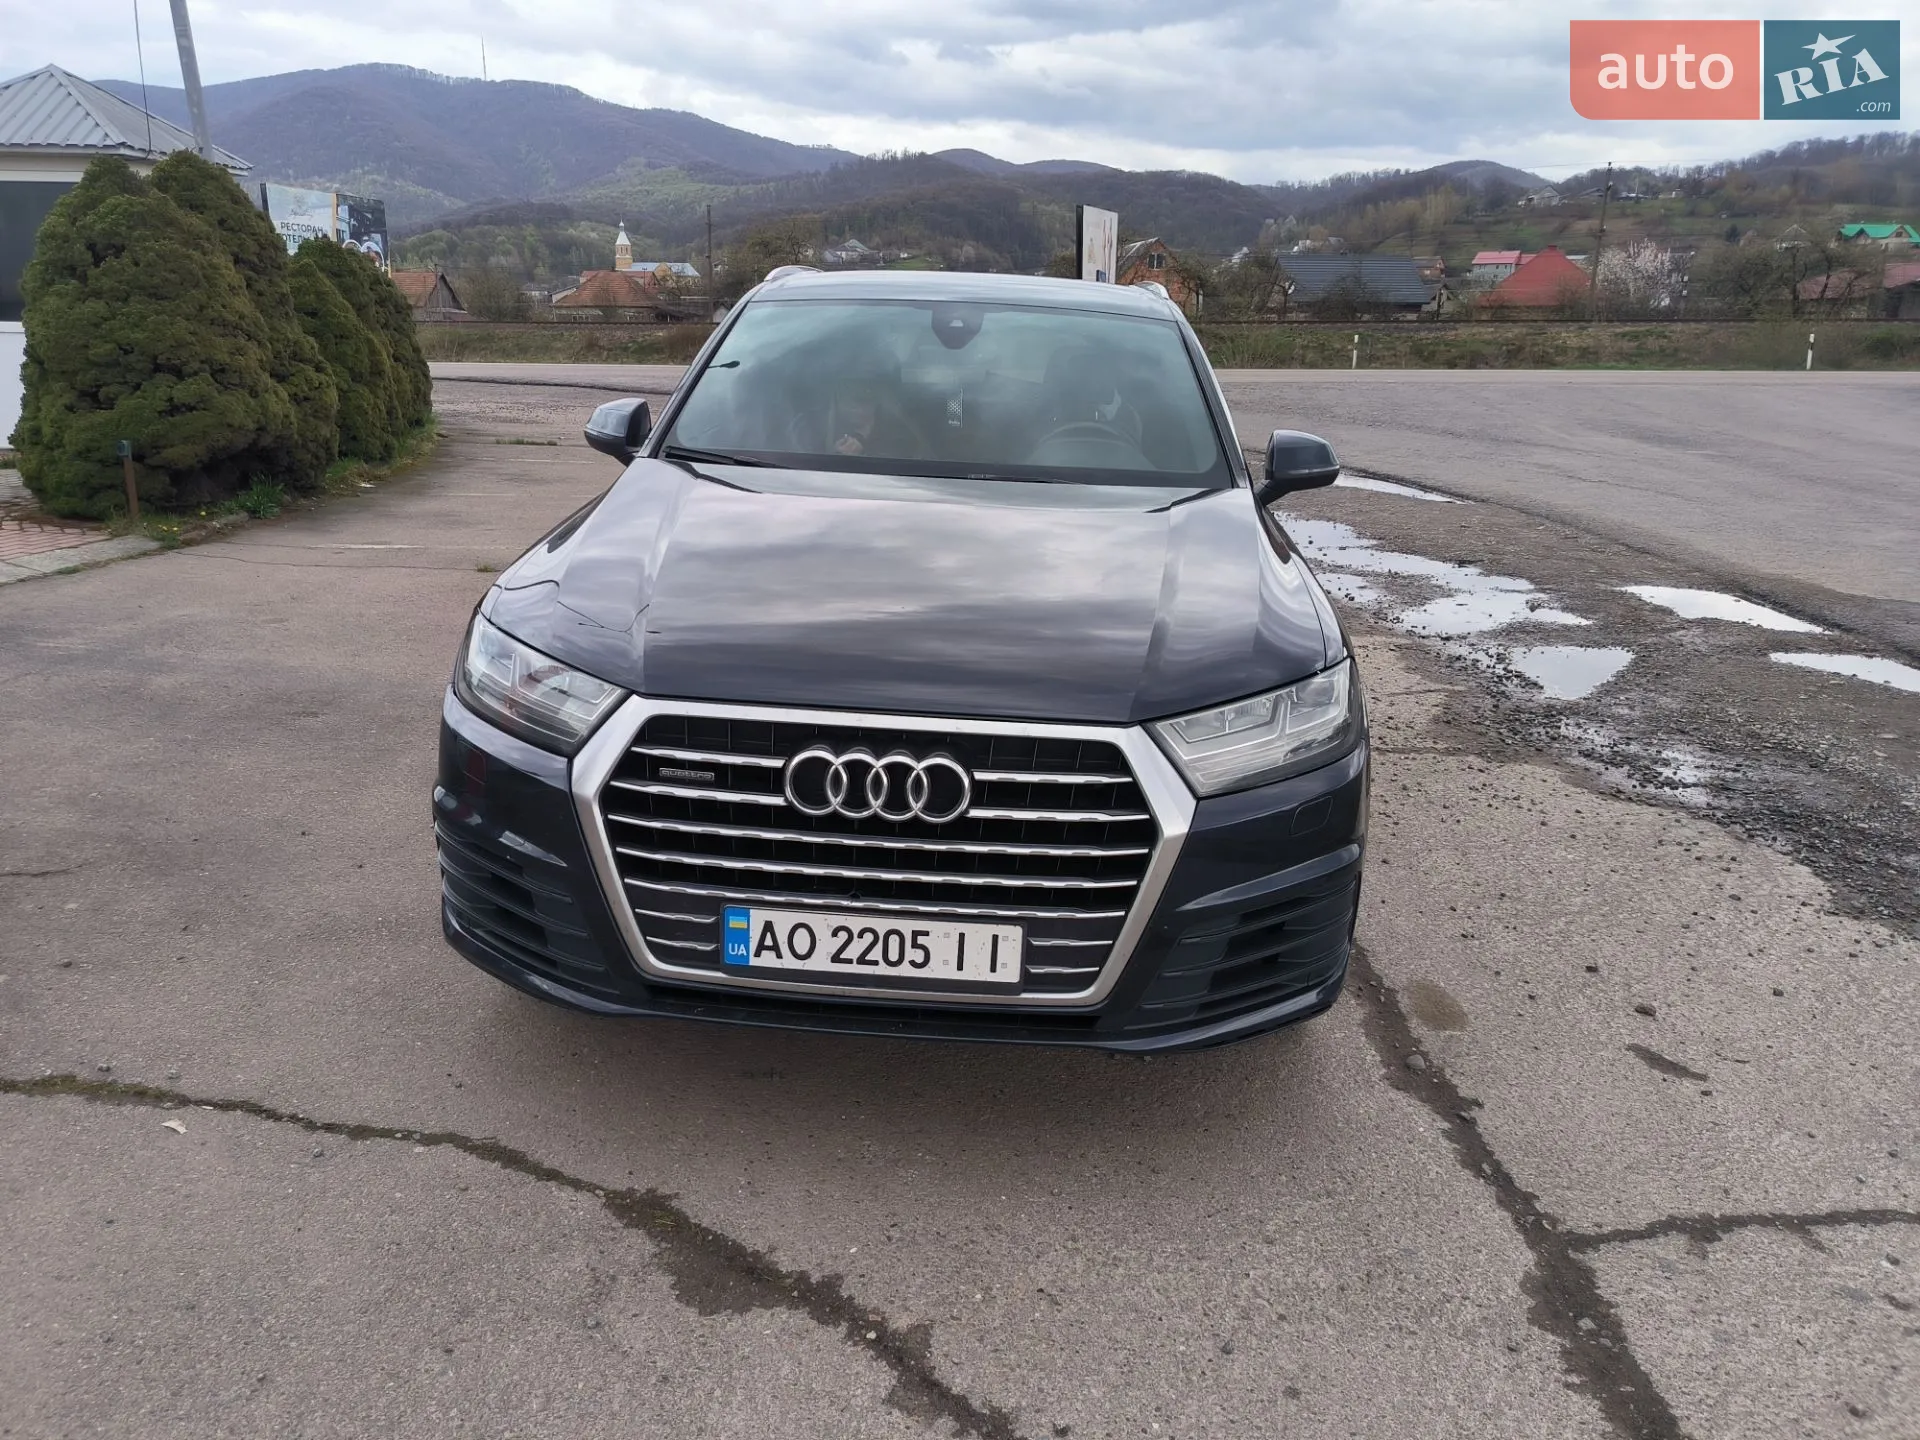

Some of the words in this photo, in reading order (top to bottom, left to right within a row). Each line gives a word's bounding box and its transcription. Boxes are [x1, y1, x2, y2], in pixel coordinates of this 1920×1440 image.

[280, 221, 324, 235] РЕСТОРАН
[728, 943, 748, 956] UA
[753, 920, 817, 961] AO
[830, 925, 931, 970] 2205
